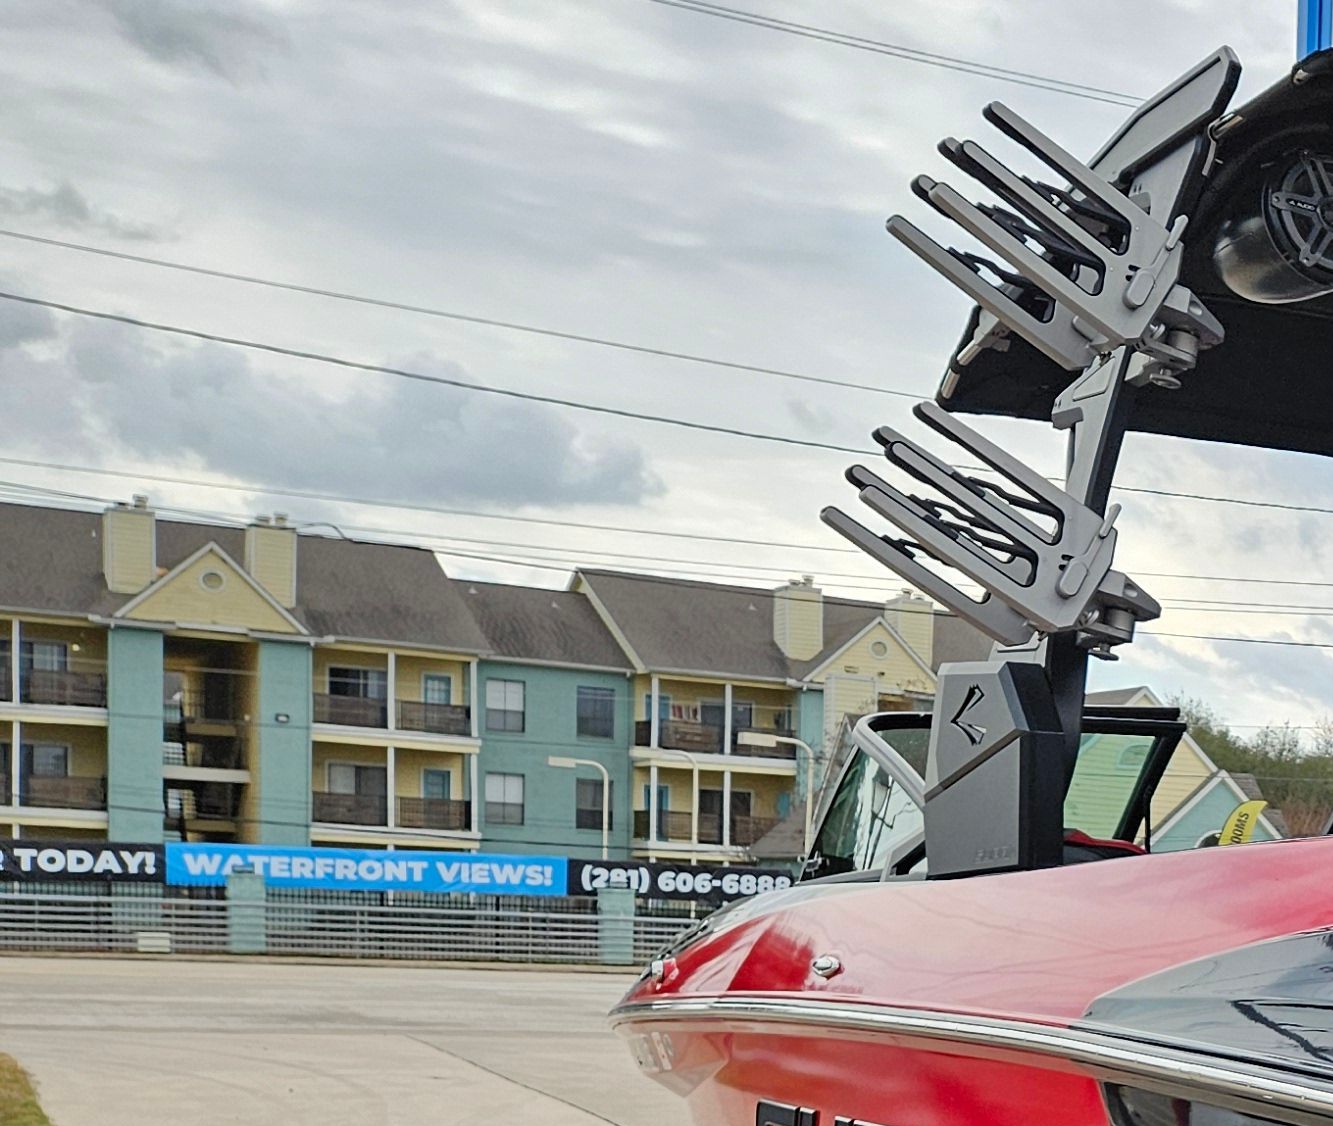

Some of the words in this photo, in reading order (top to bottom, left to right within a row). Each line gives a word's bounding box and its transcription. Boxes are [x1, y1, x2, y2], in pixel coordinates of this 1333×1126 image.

[13, 847, 156, 875] TODAY!
[183, 850, 430, 885] WATERFRONT
[436, 861, 553, 888] VIEWS!
[581, 864, 650, 894] (281)
[657, 870, 792, 896] 606-6888
